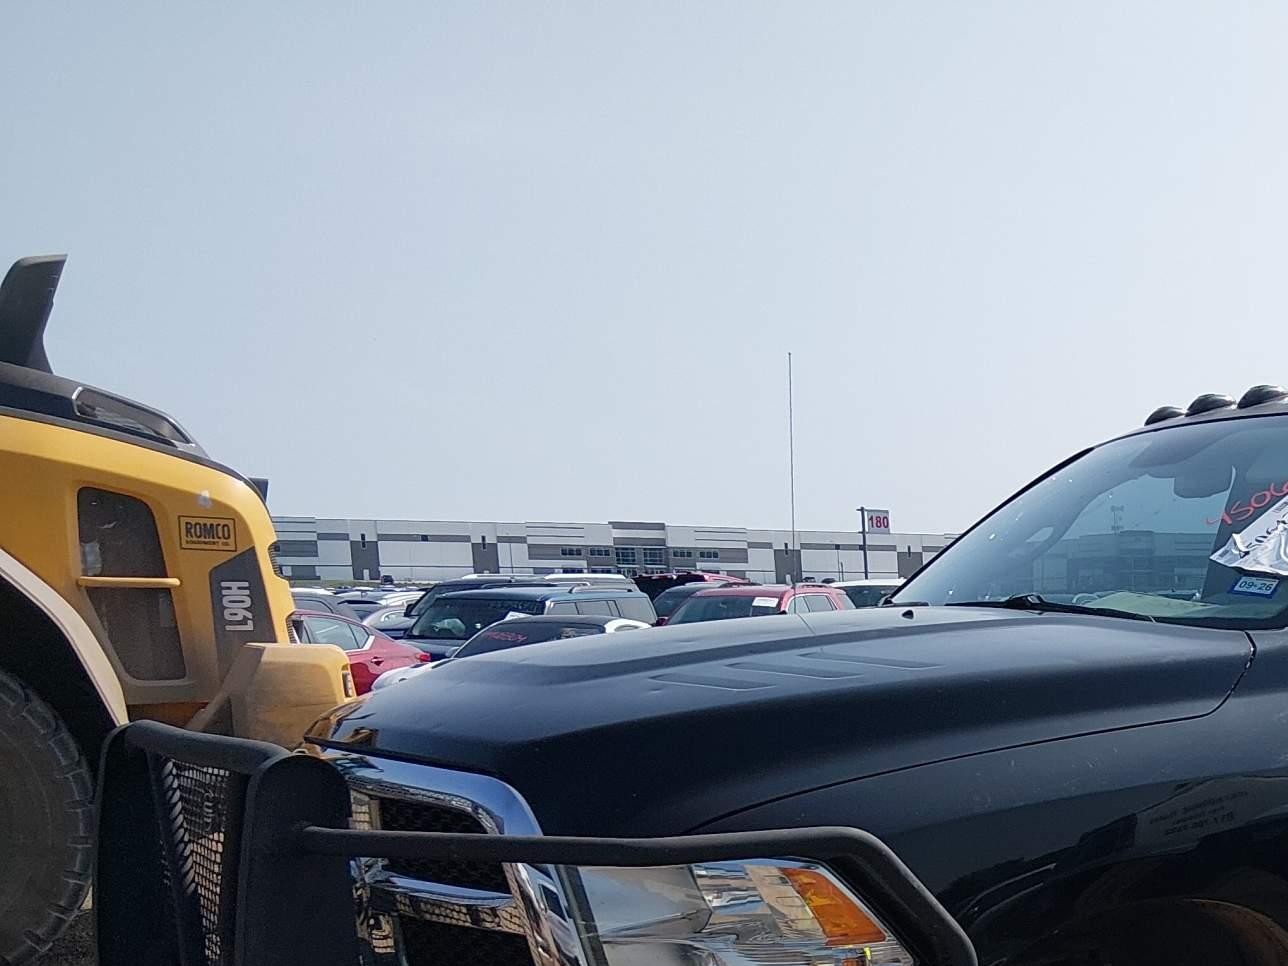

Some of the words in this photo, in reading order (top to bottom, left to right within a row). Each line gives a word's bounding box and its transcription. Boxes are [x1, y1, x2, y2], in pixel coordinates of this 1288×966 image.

[185, 522, 231, 540] ROMCO
[868, 515, 889, 529] 180
[220, 581, 254, 631] L90H
